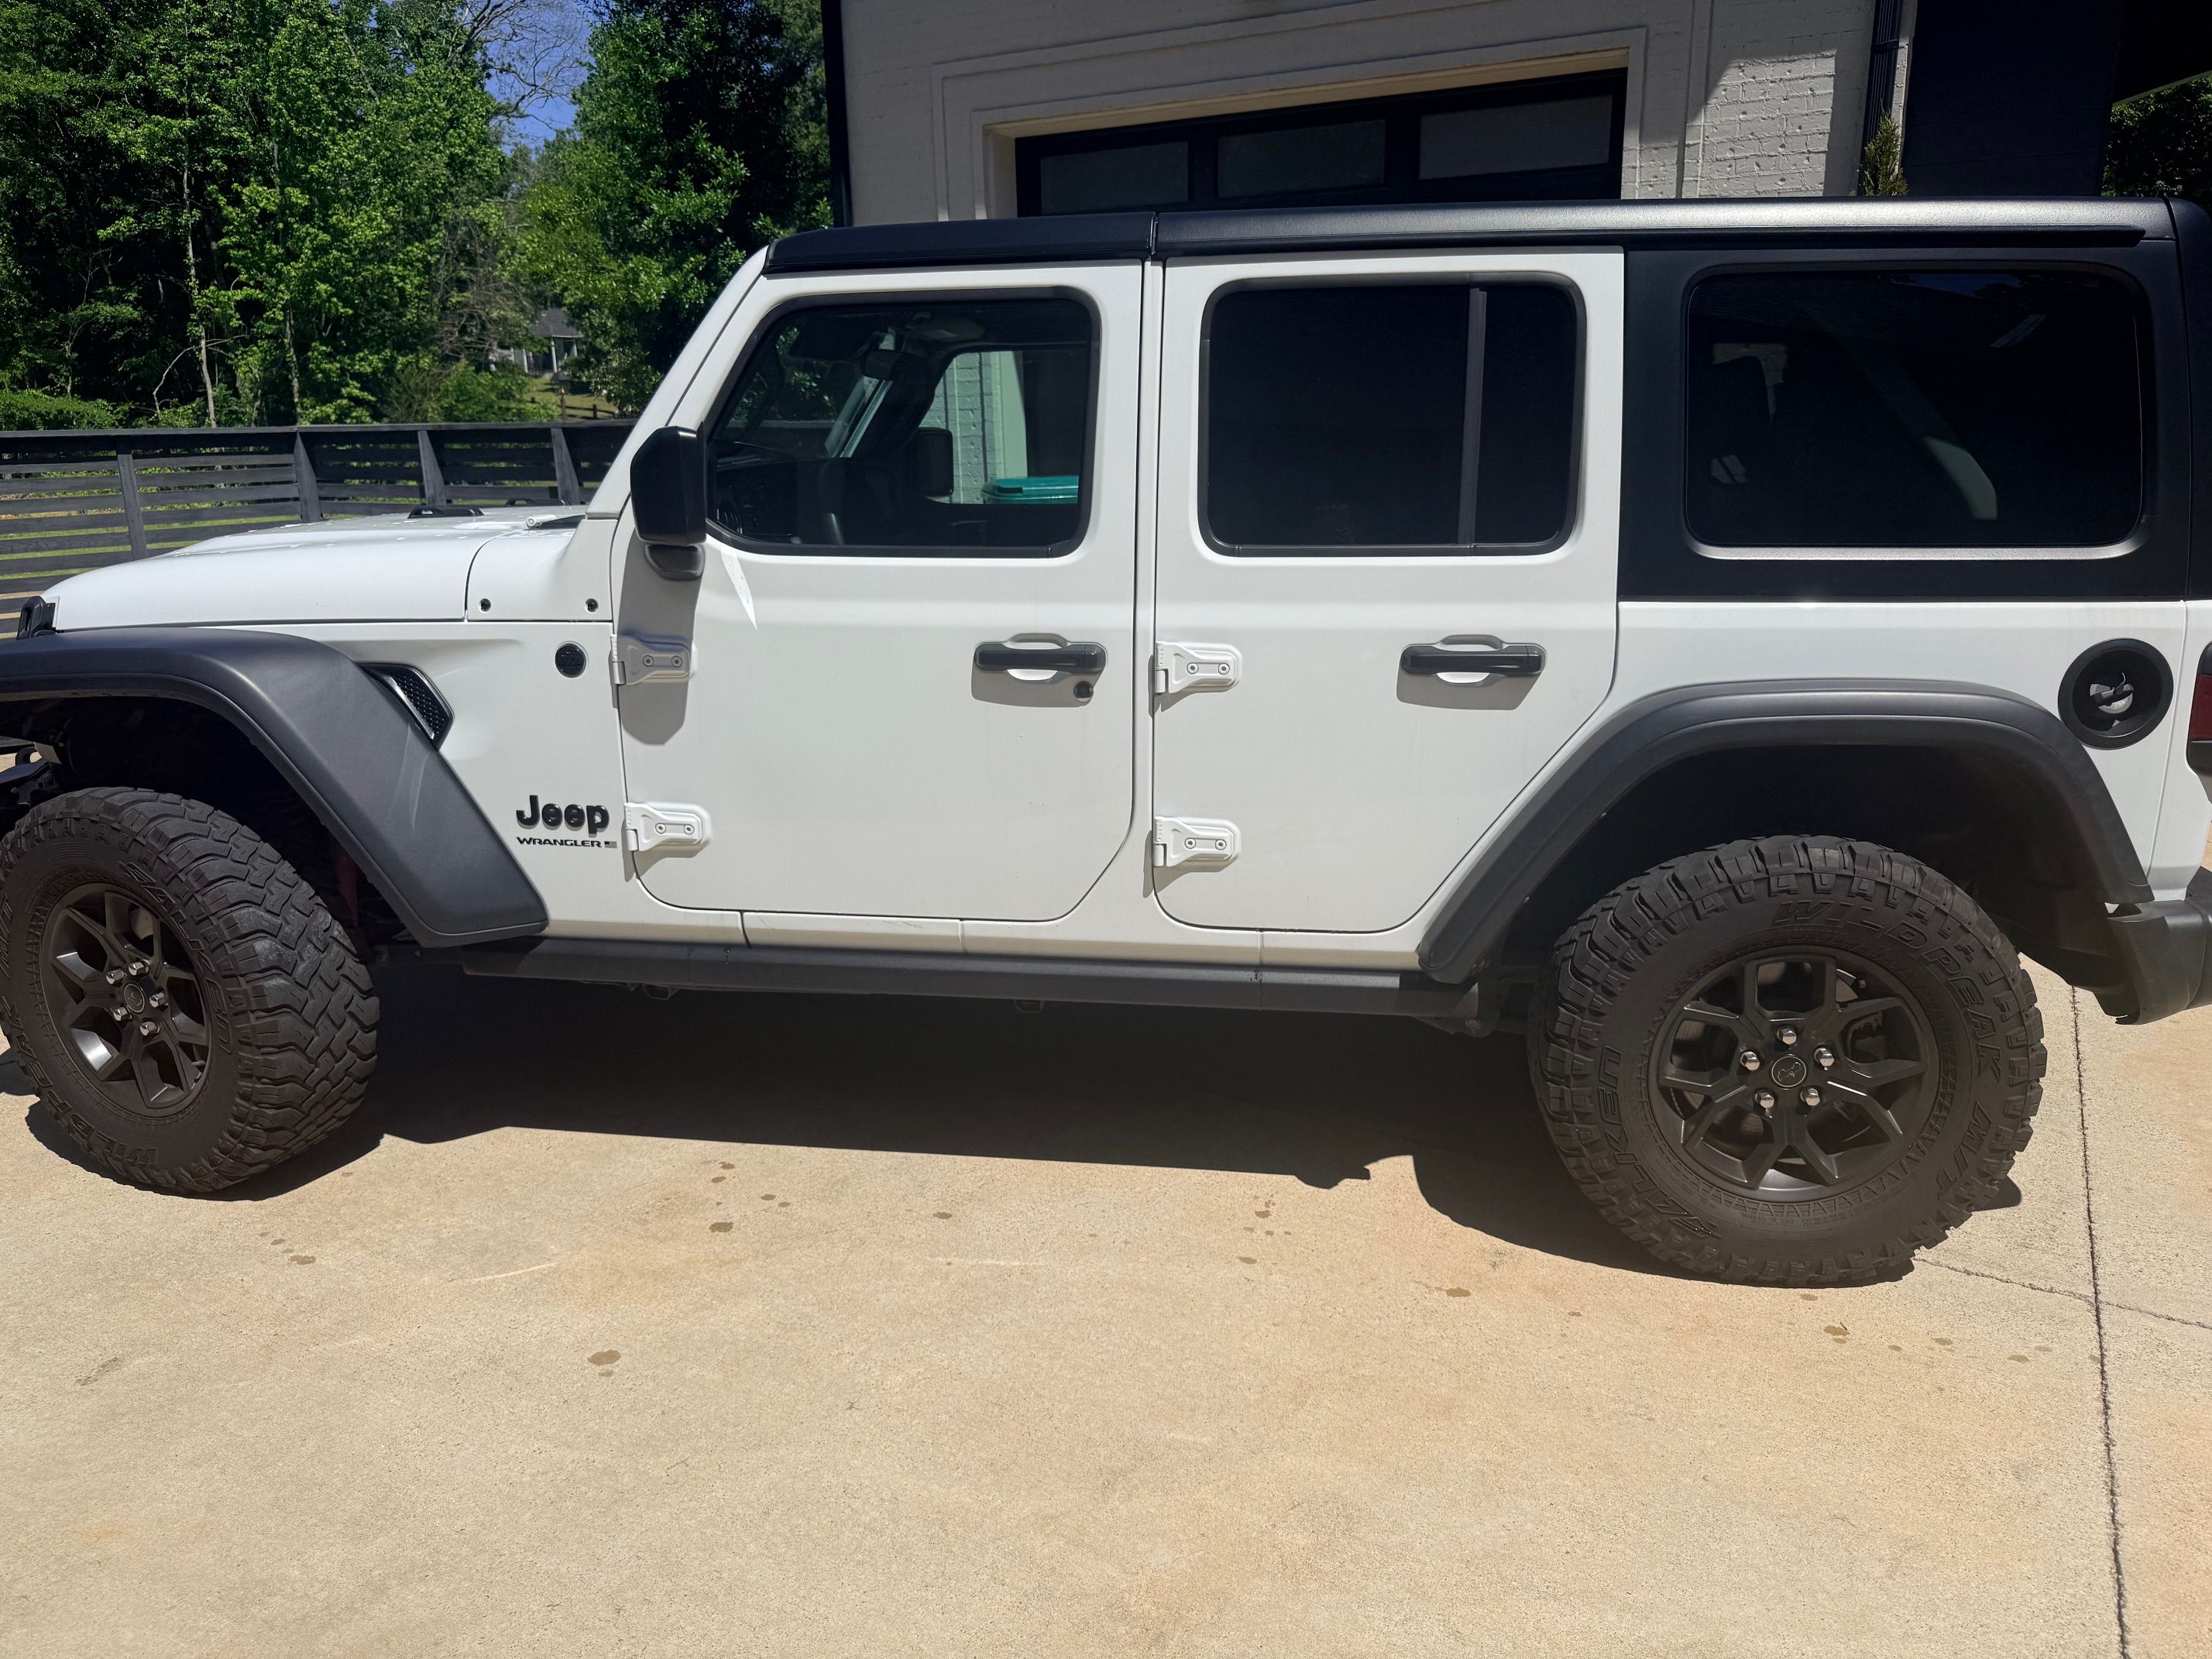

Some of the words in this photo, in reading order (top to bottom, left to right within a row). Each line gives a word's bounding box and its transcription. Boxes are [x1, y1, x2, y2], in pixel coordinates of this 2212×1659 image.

[516, 795, 610, 836] Jeep
[516, 836, 603, 848] WRANGLER
[118, 860, 234, 1054] FALKEN
[1771, 900, 2002, 1084] WILDPEAK
[1936, 1100, 1994, 1200] M/T
[1598, 1044, 1723, 1239] FALKEN
